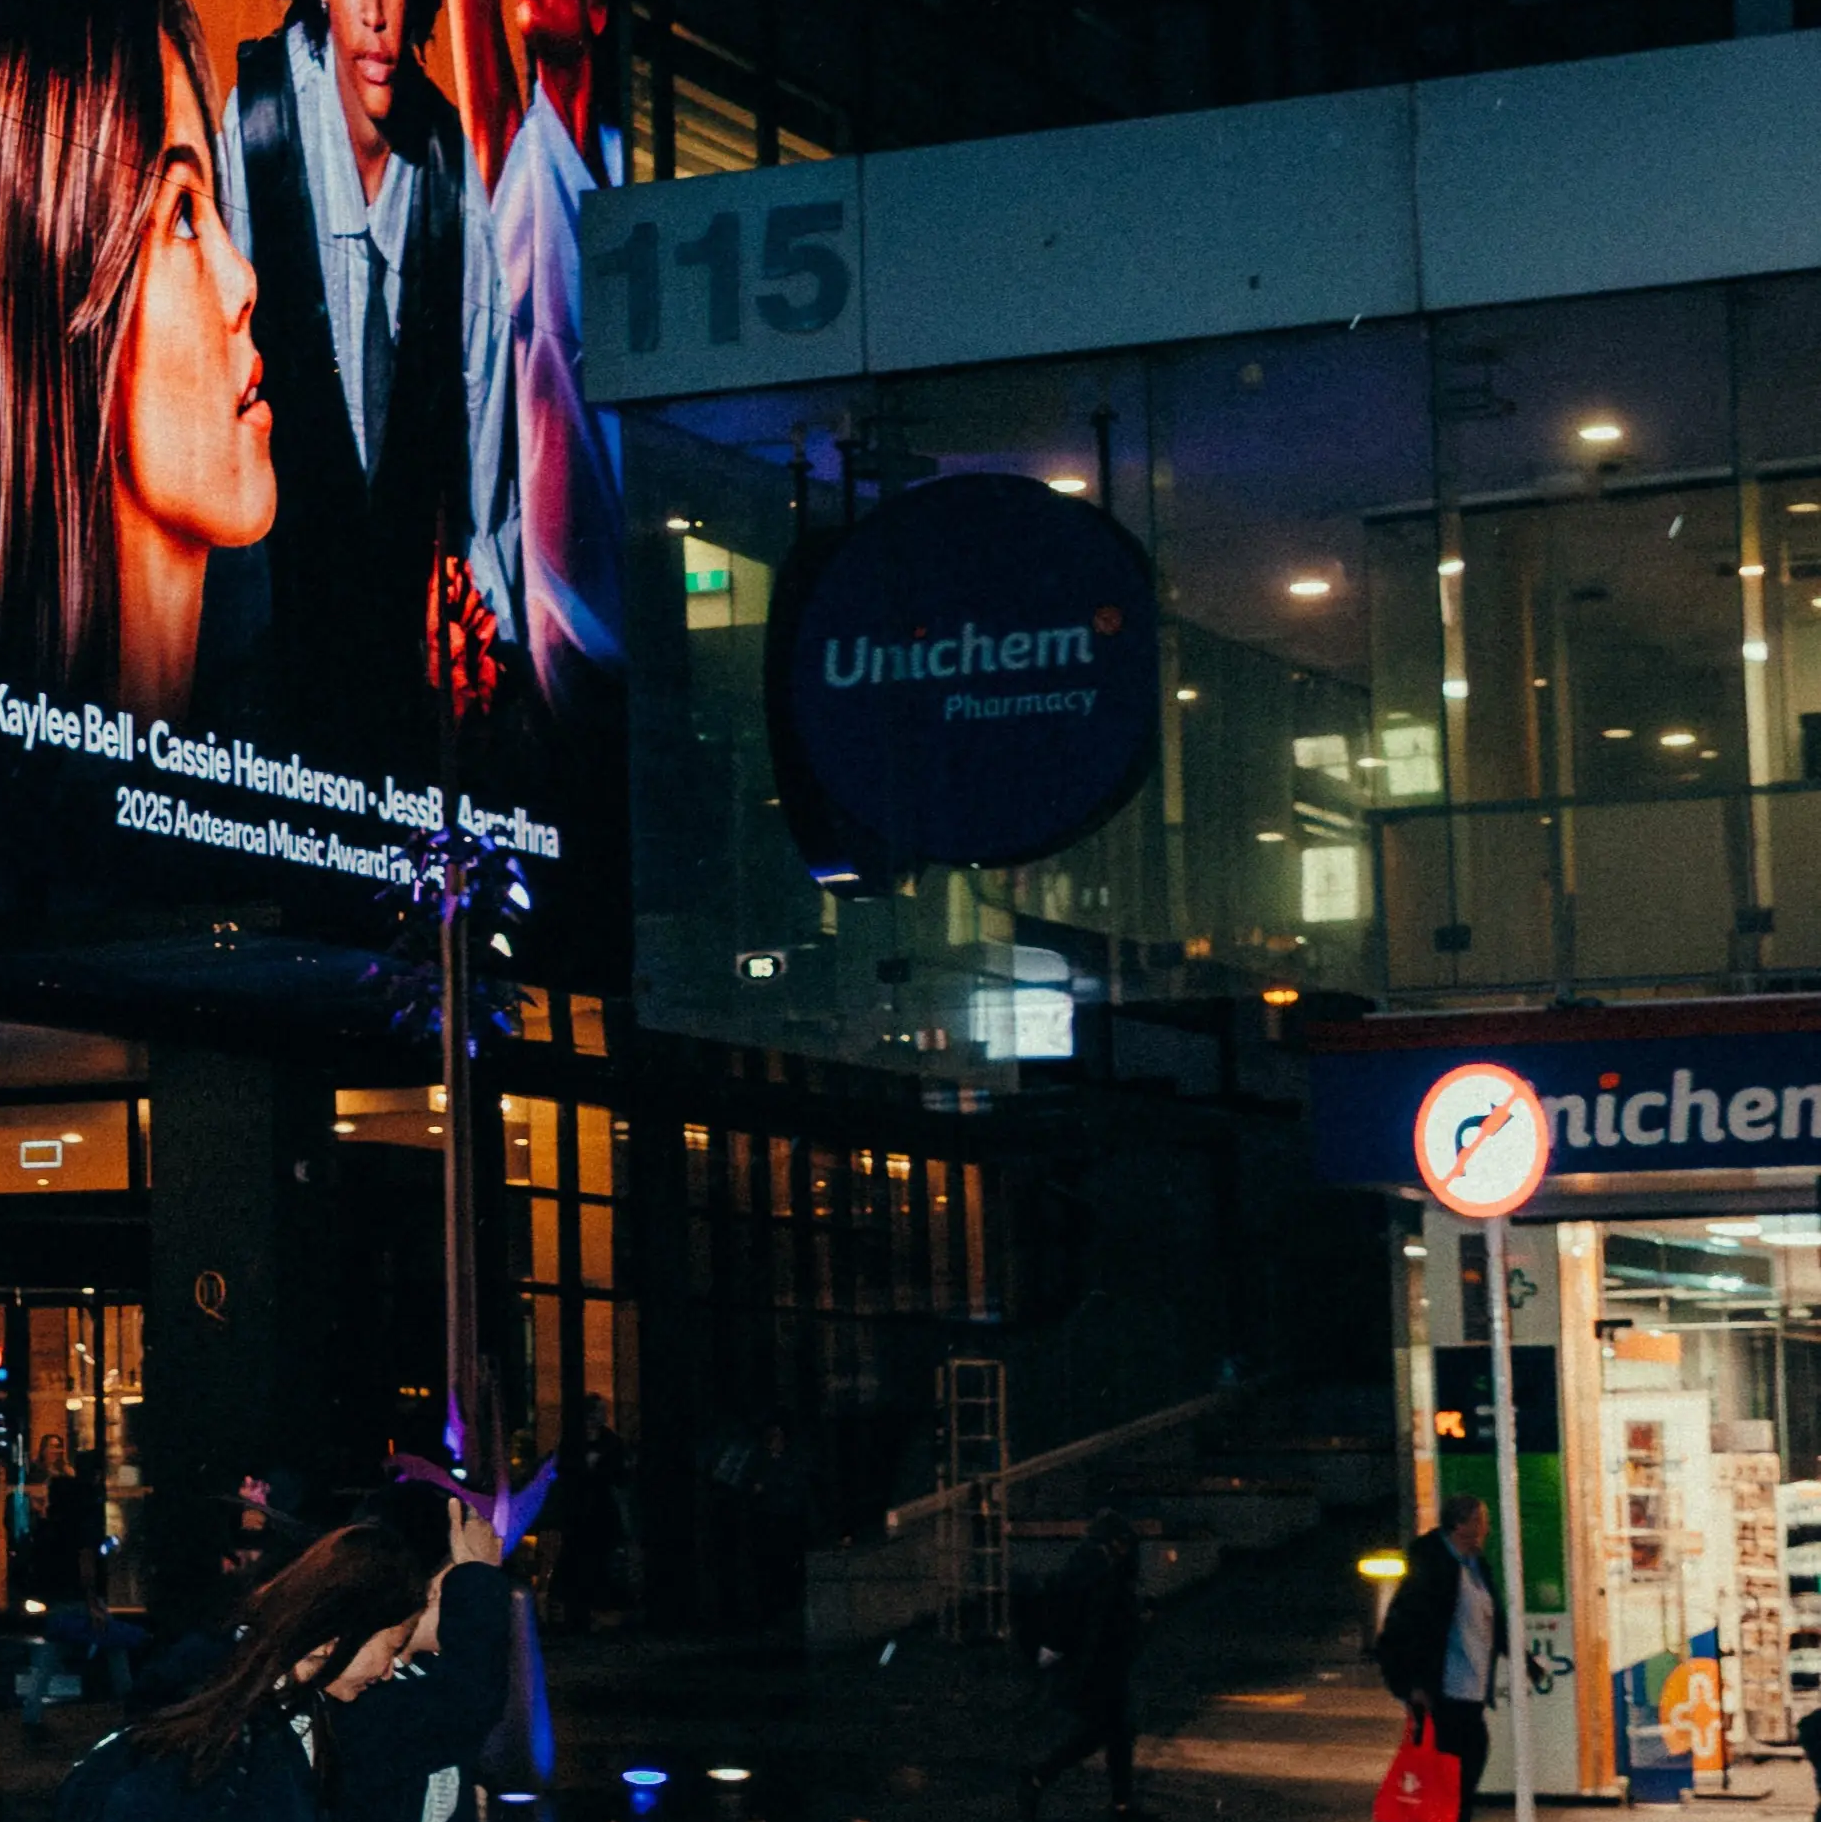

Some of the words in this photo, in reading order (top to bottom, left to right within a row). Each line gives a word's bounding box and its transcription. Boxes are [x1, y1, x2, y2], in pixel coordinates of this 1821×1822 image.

[588, 200, 849, 354] 115
[824, 621, 1094, 688] Unichem
[942, 688, 1098, 721] Pharmacy
[83, 702, 134, 762] Bell
[149, 719, 231, 784] Cassie
[233, 739, 366, 815] Henderson
[378, 775, 444, 832] JessB
[116, 785, 173, 836] 2025
[173, 799, 267, 855] Aotearoa
[267, 818, 326, 868] Music
[326, 832, 388, 881] Award
[1534, 1068, 1821, 1148] niche
